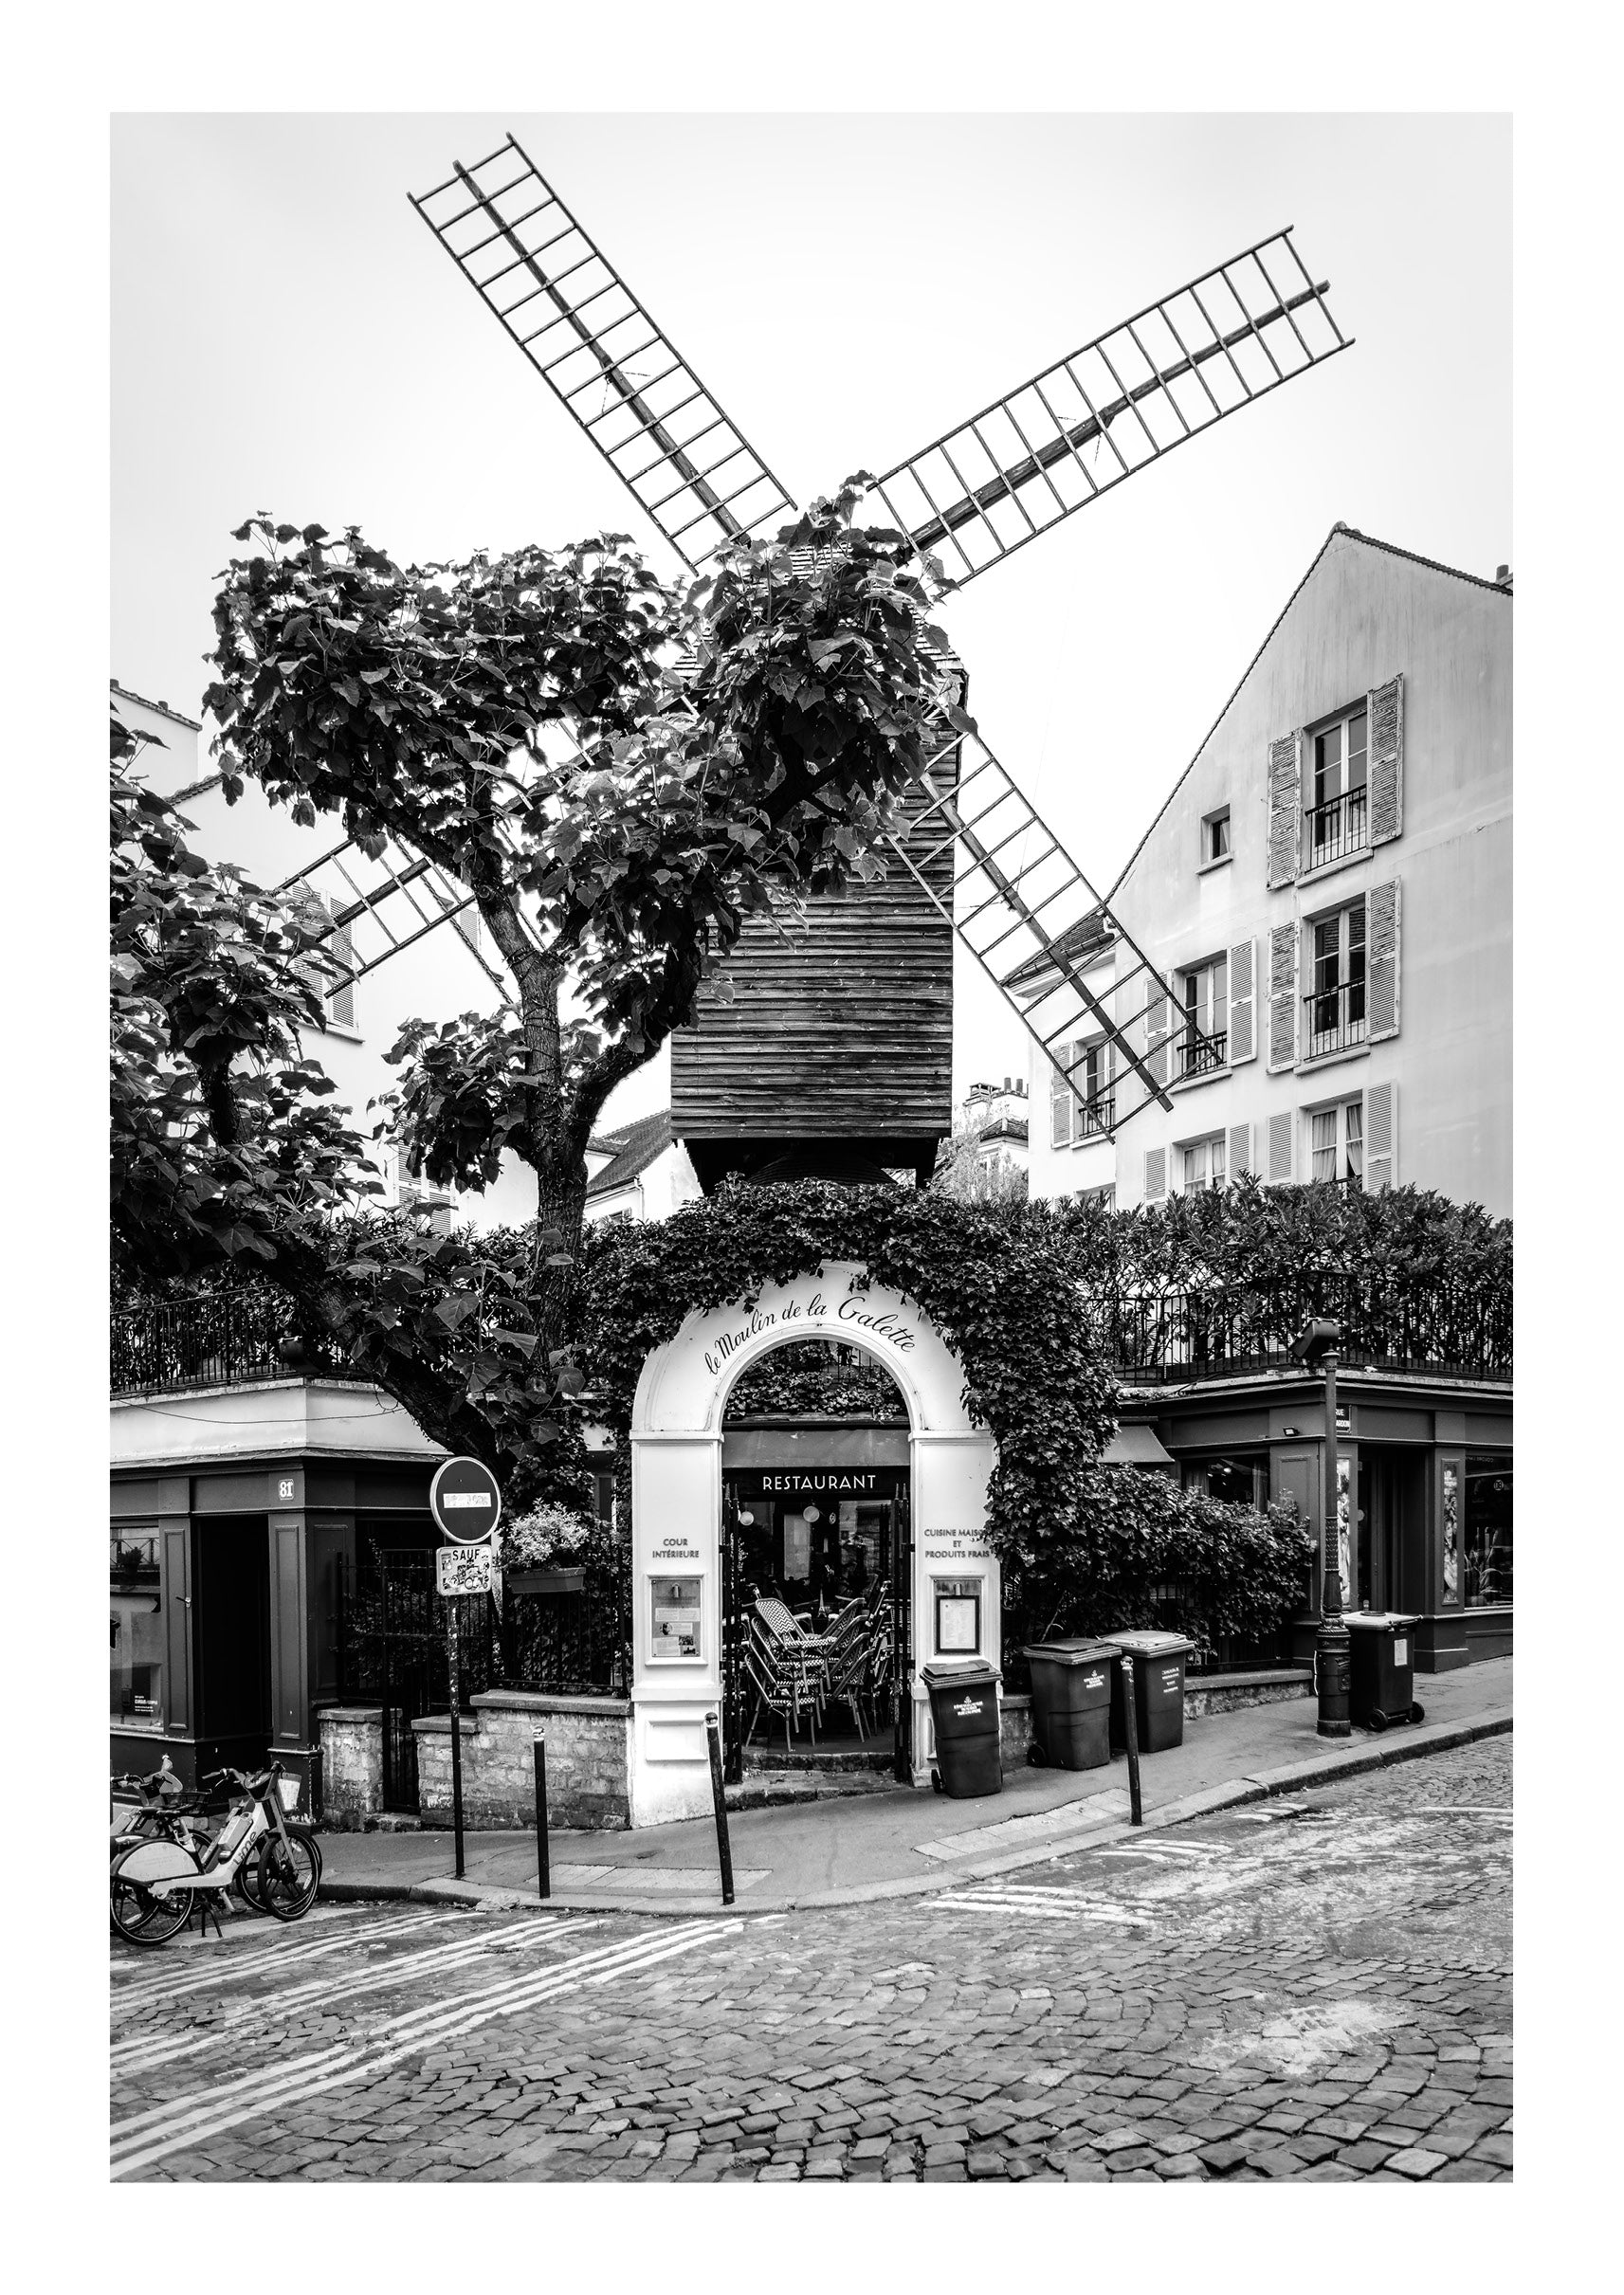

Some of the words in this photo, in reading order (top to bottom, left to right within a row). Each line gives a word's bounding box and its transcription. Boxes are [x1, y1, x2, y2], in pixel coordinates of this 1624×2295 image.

[704, 1352, 721, 1375] le
[714, 1308, 777, 1359] Moulin
[781, 1300, 801, 1321] de
[807, 1293, 828, 1317] la
[838, 1296, 916, 1353] Galette
[762, 1474, 876, 1490] RESTAURANT
[663, 1538, 688, 1546] COUR
[953, 1539, 961, 1548] ET
[452, 1549, 480, 1560] SAUF
[652, 1549, 700, 1558] INTÉRIEURE
[925, 1550, 966, 1558] PRODUITS
